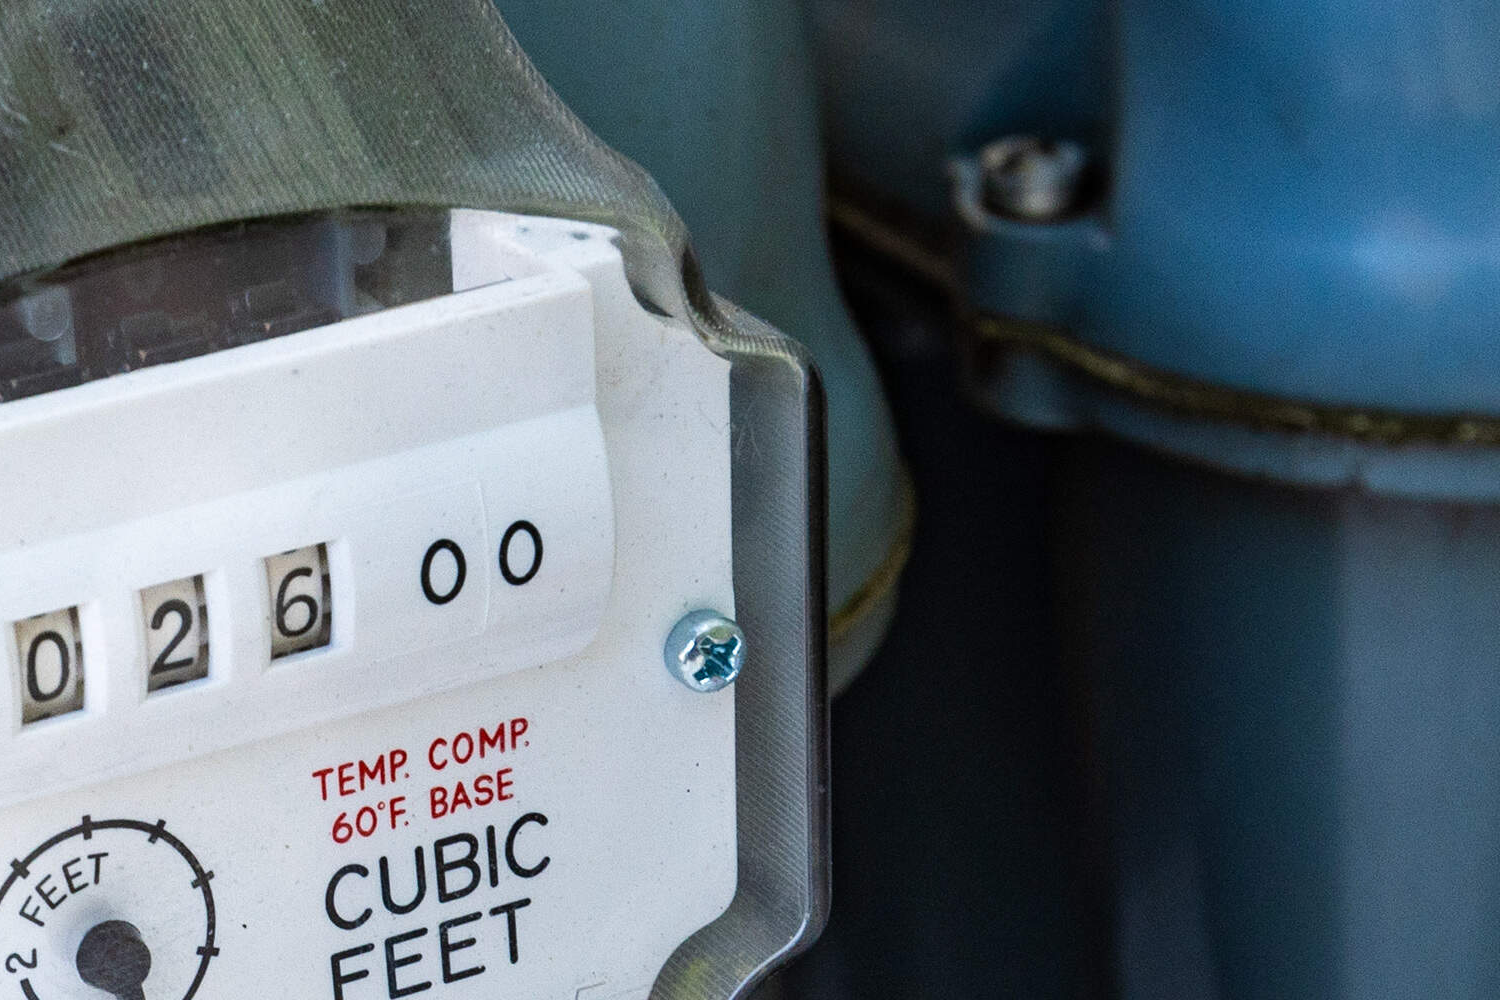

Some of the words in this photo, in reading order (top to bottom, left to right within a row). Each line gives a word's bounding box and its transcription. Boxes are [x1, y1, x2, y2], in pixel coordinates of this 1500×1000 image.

[24, 628, 71, 703] 0
[147, 597, 196, 677] 2
[273, 566, 320, 638] 6
[311, 748, 410, 802] TEMP.
[427, 716, 531, 771] COMP.
[429, 767, 515, 820] BASE
[17, 851, 110, 928] FEET
[324, 811, 552, 931] CUBIC
[4, 947, 38, 975] 2
